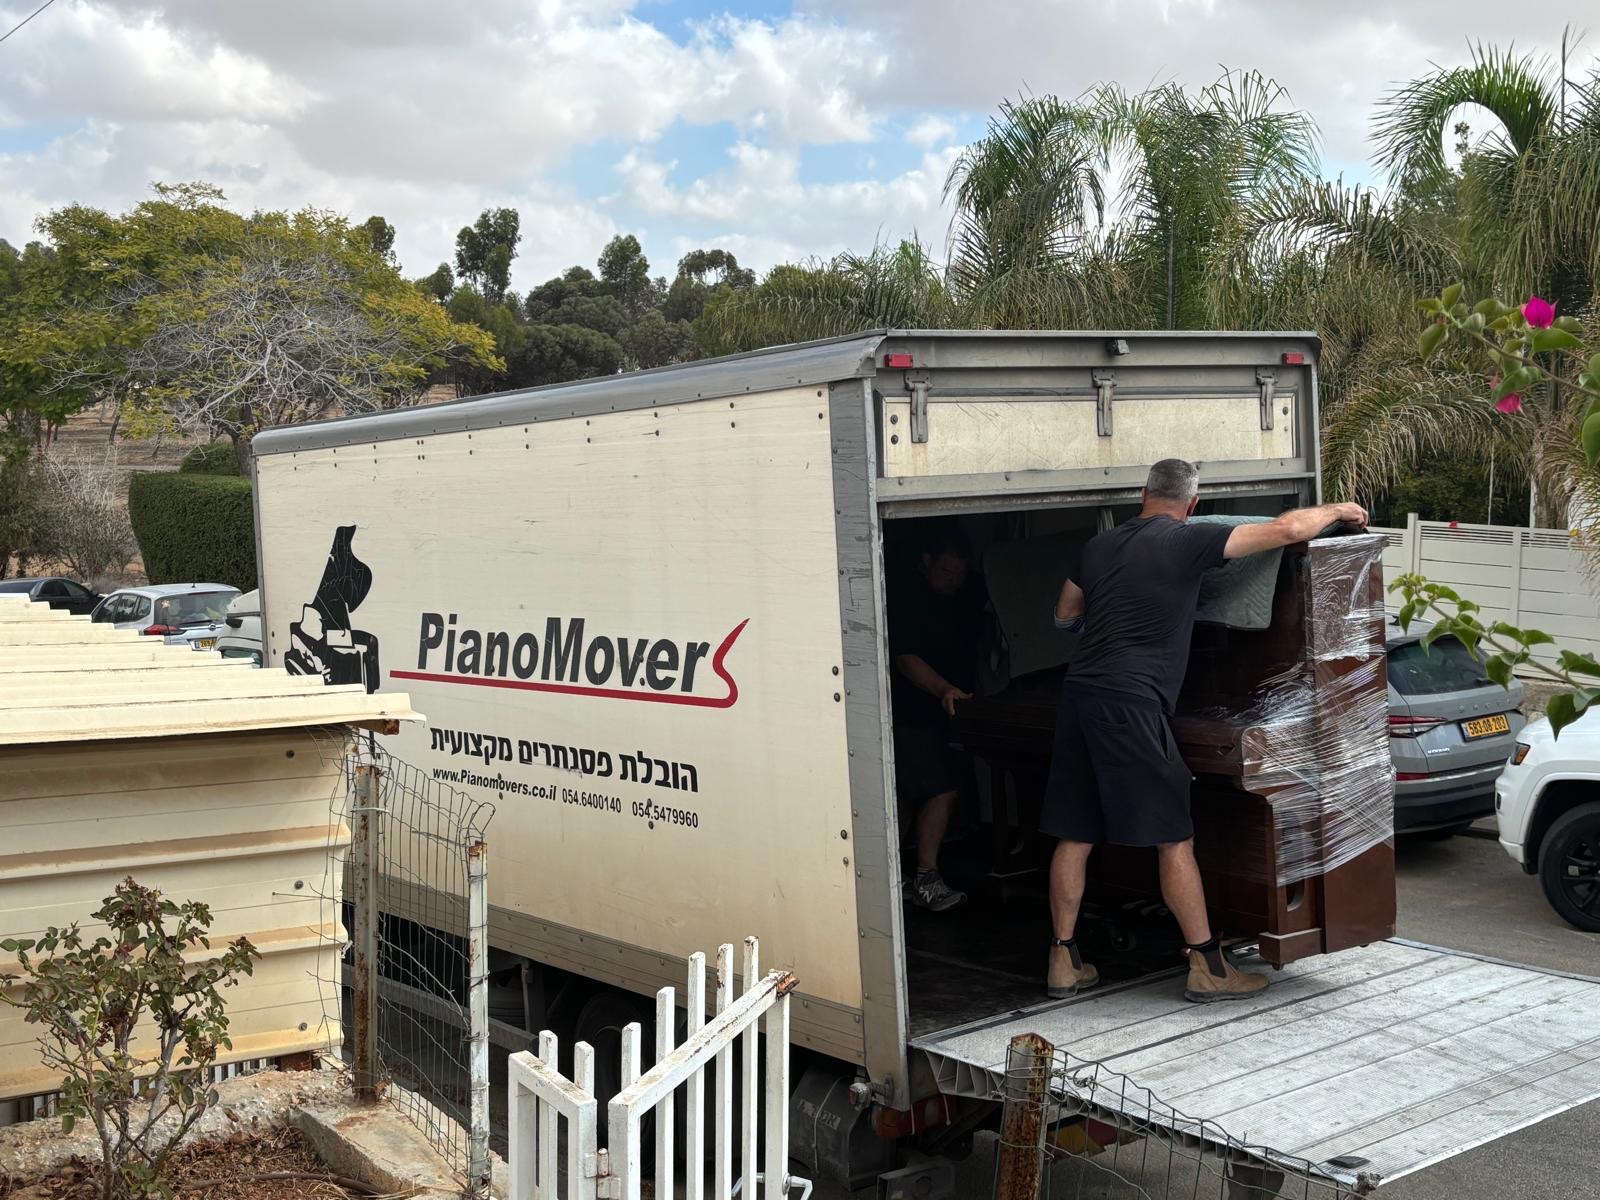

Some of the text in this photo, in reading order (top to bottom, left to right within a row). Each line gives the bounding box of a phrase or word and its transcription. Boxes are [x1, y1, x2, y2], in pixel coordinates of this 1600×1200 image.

[430, 727, 698, 792] הובלת פסנתרים מקצועית
[432, 768, 699, 829] www.Pianomovers.co.il 054.6400140 054.5479960
